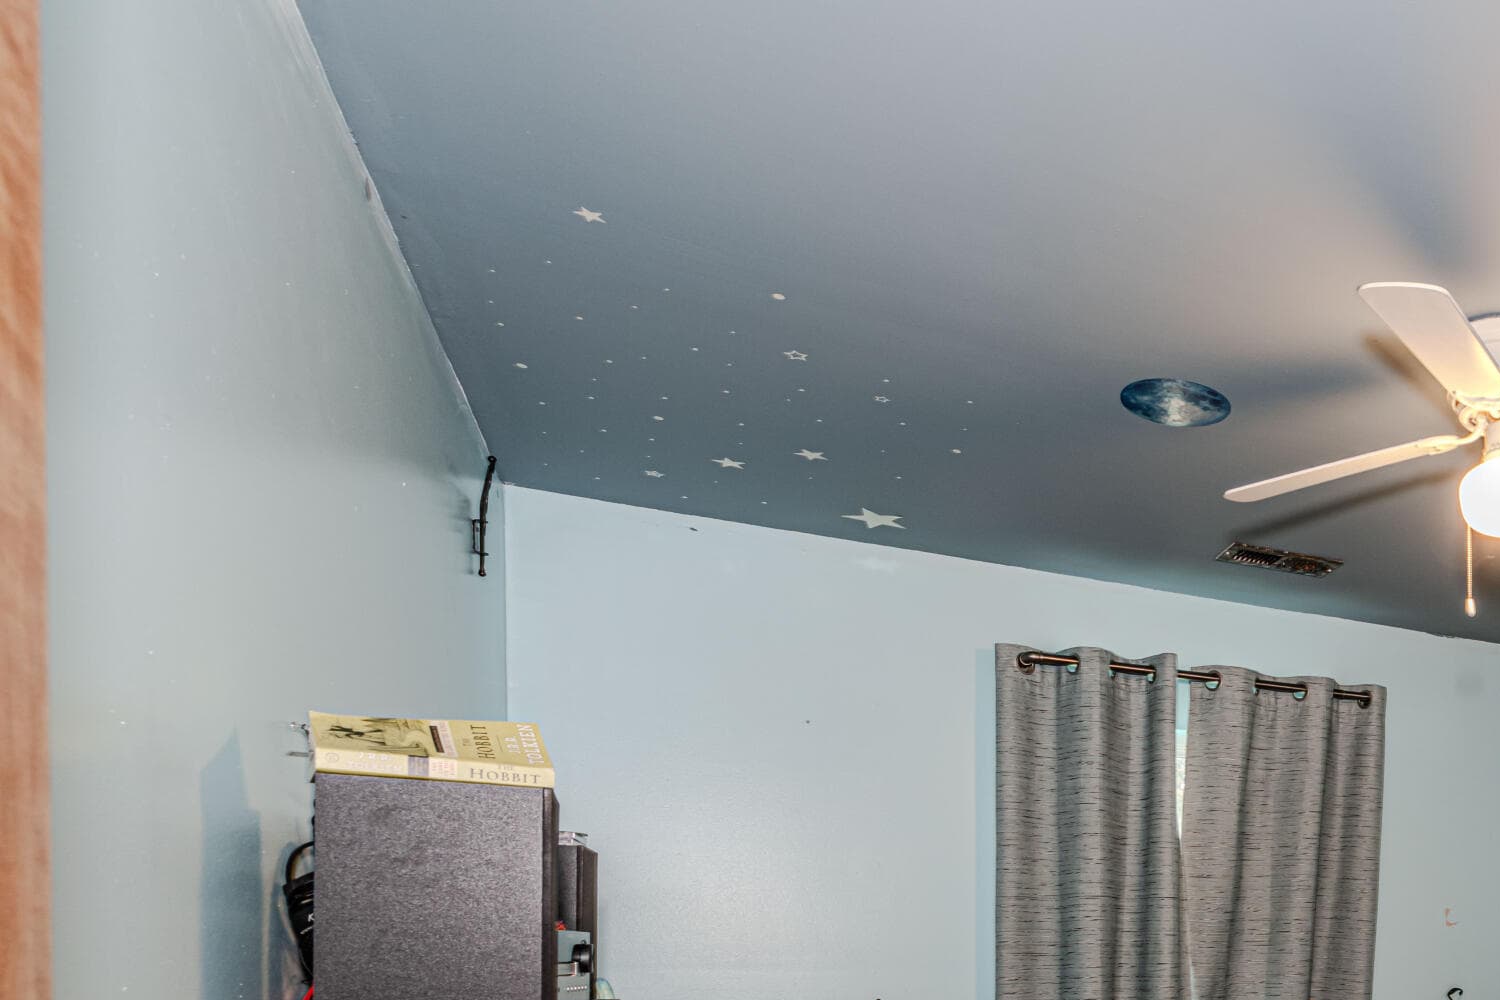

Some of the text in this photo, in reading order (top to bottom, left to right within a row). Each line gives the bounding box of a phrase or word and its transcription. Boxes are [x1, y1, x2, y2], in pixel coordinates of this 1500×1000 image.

[470, 724, 496, 759] HOBBIT
[516, 723, 545, 764] TOLKIEN
[469, 767, 542, 784] HOBBIT
